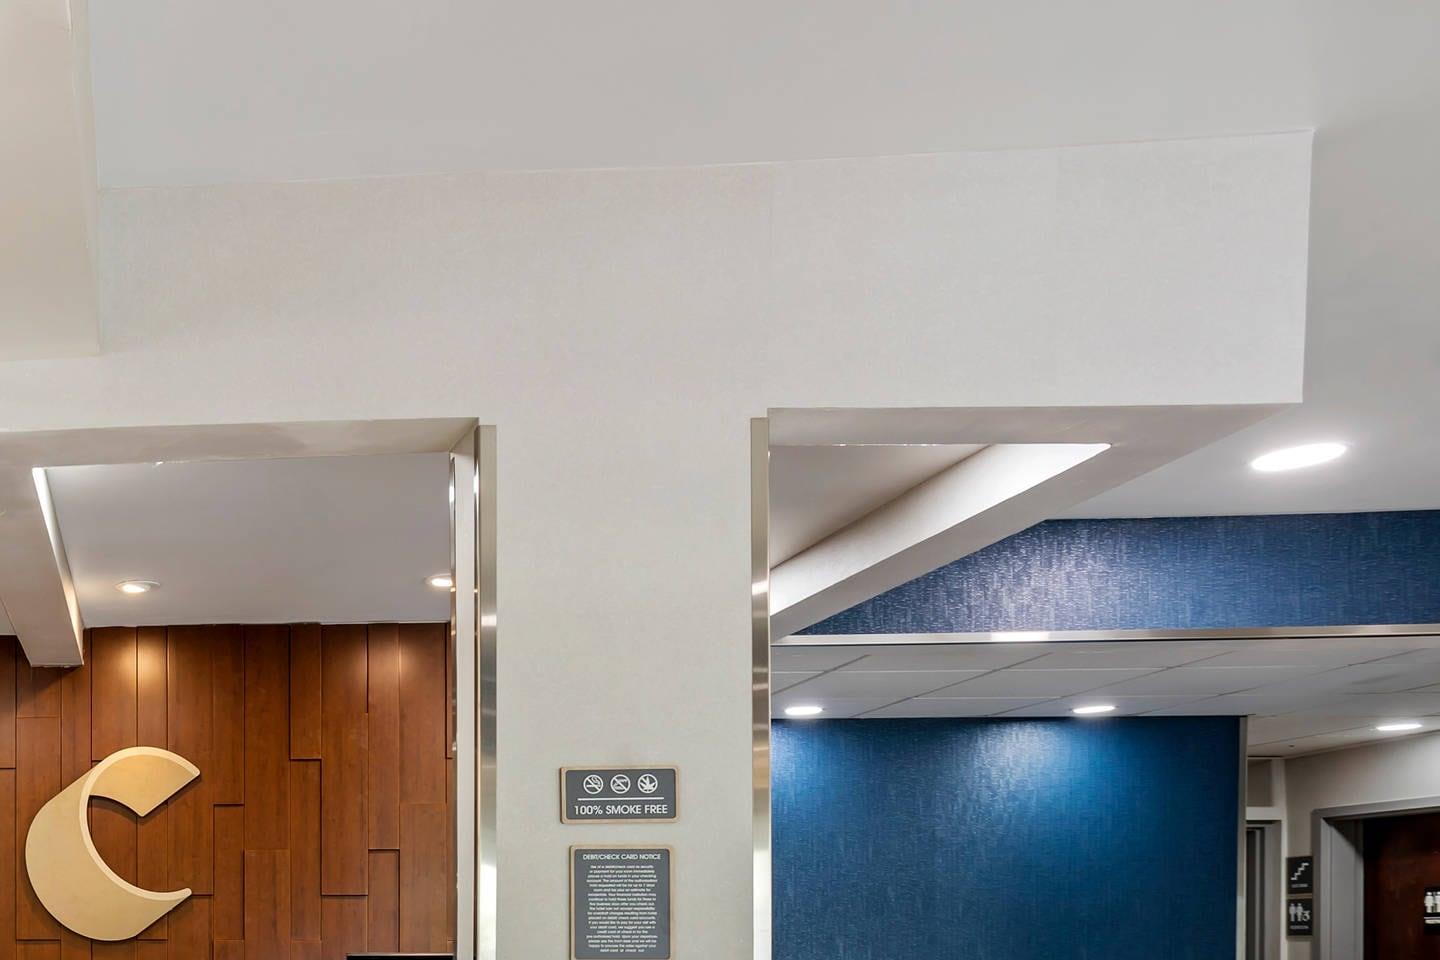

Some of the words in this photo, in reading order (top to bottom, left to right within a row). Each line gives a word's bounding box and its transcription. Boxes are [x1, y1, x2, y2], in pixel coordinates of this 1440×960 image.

[574, 805, 603, 815] 100%
[605, 804, 642, 815] SMOKE
[644, 804, 668, 814] FREE
